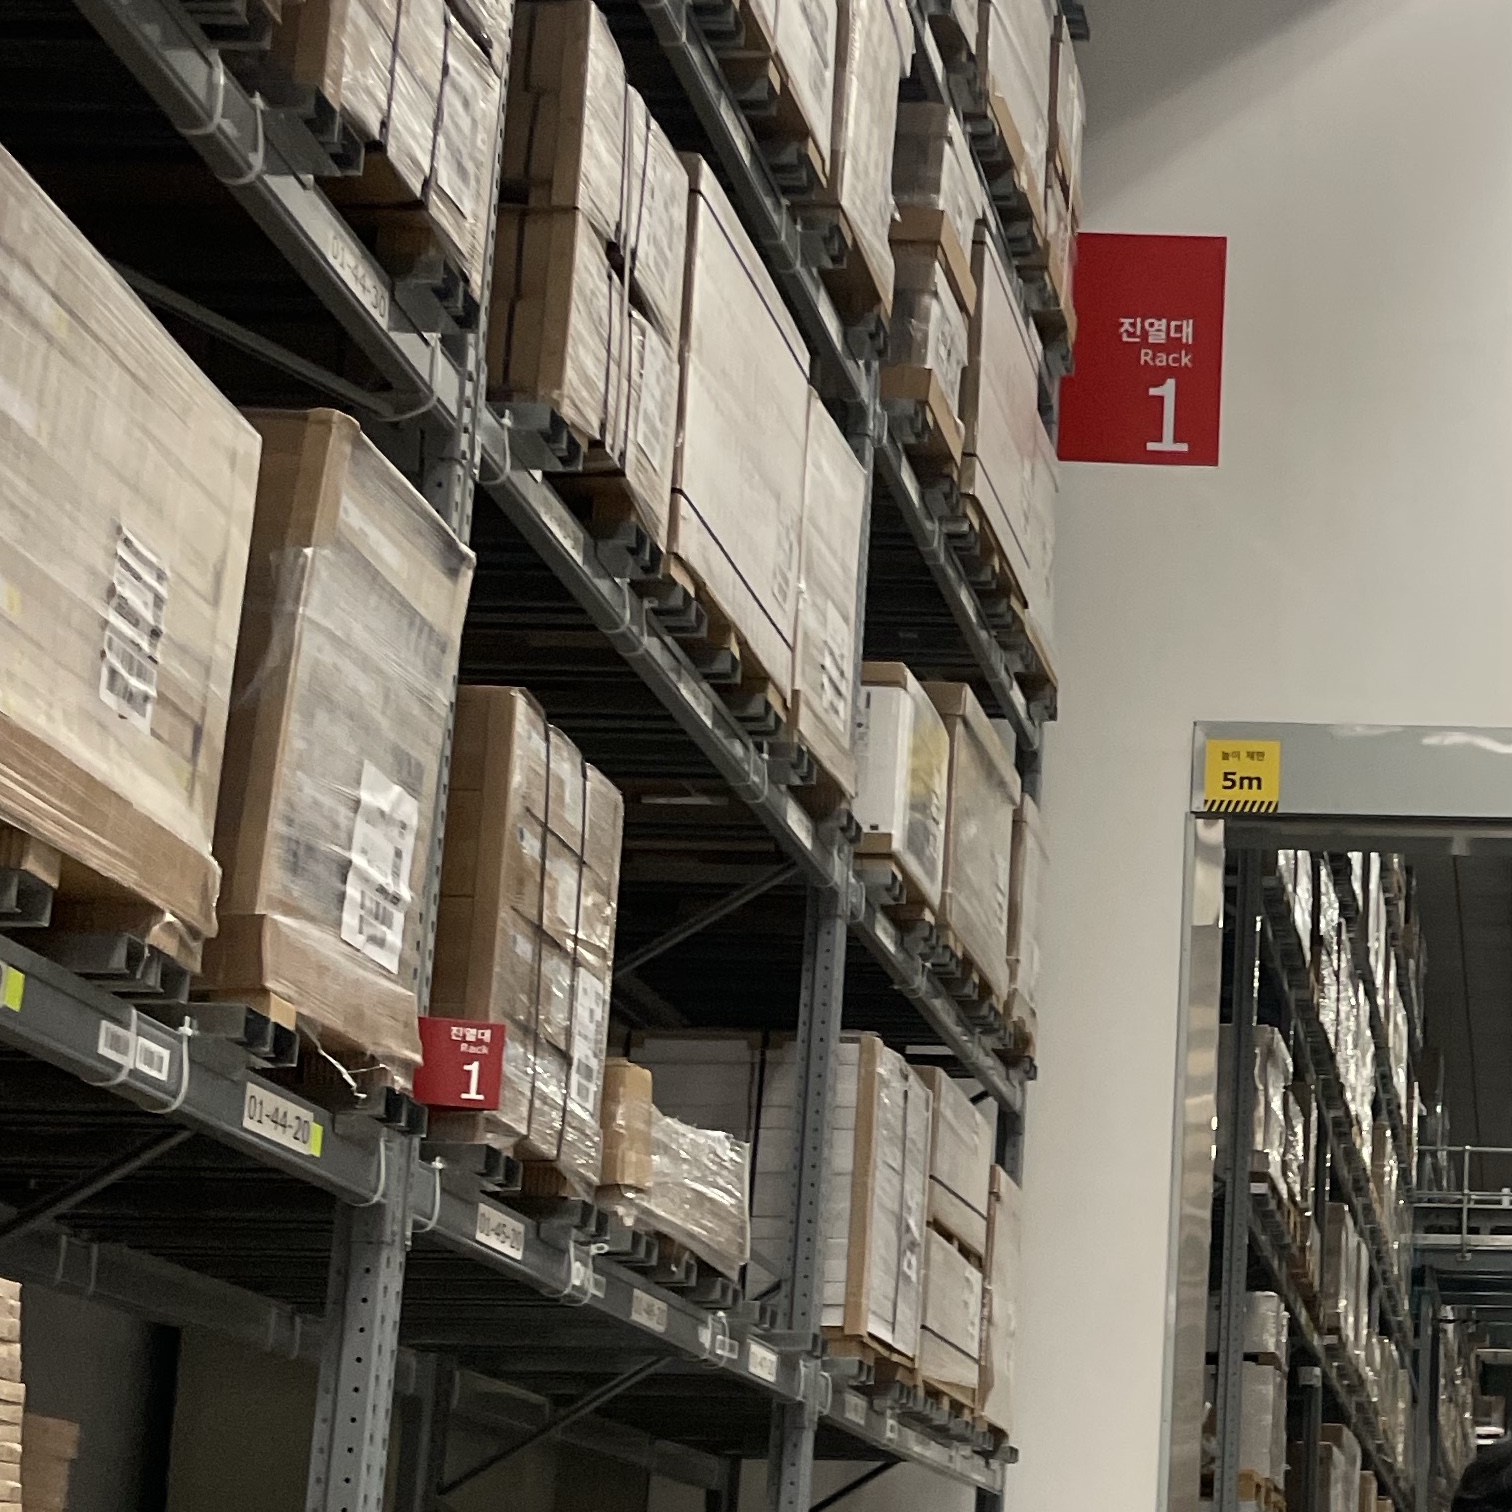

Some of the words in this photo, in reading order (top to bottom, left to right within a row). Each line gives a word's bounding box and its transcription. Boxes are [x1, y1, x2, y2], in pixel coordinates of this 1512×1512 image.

[1118, 317, 1193, 345] 진열대
[1140, 349, 1192, 368] Rack
[1146, 378, 1189, 453] 1
[1221, 771, 1262, 791] 5m
[450, 1026, 492, 1043] 진열대
[460, 1043, 489, 1055] Rack
[460, 1060, 485, 1100] 1
[247, 1094, 311, 1145] 01-44-20
